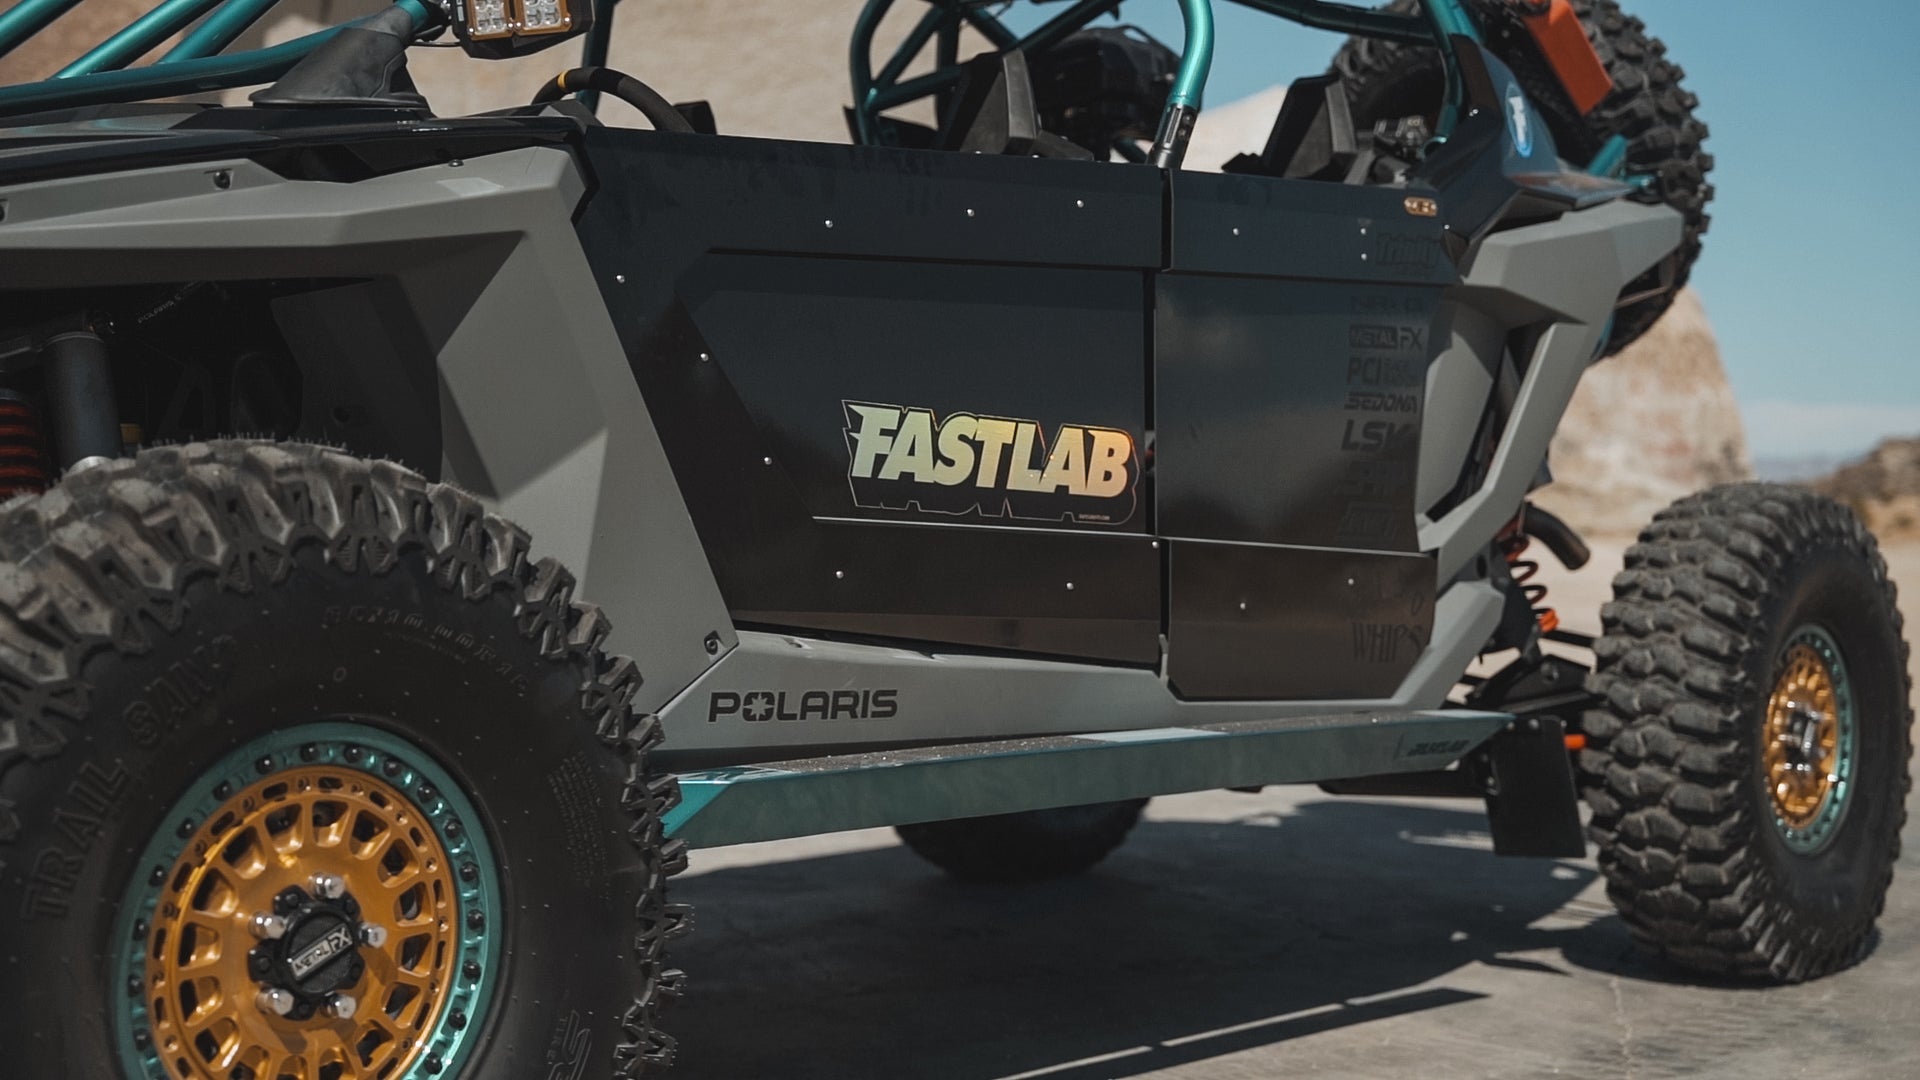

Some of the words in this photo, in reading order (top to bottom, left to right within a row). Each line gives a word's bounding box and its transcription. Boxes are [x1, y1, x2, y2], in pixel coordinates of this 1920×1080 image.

[1346, 357, 1381, 385] PCI
[1344, 391, 1417, 413] SEDONA
[848, 404, 1132, 498] FASTLAB
[1352, 622, 1424, 664] WHIPS
[708, 689, 898, 722] POLARIS
[21, 760, 129, 920] TRAIL
